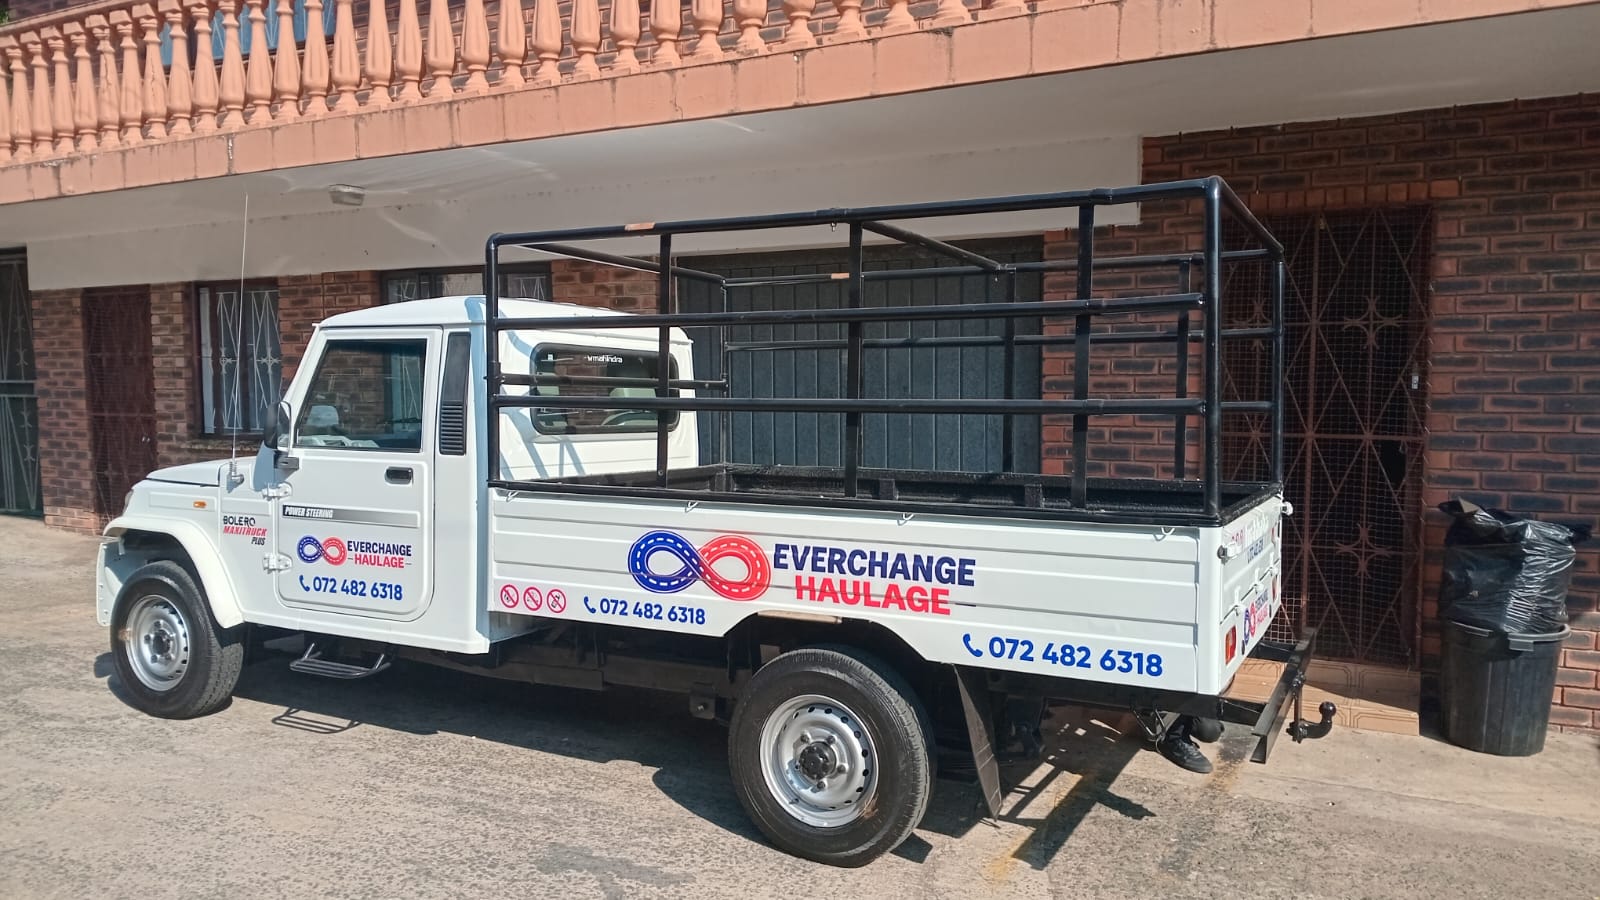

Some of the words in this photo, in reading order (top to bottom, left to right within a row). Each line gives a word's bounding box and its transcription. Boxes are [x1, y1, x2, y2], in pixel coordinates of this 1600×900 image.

[223, 515, 256, 527] BOLERO
[284, 506, 305, 517] POWER
[306, 508, 334, 519] STEERING
[223, 525, 267, 537] MAXITRUCK
[251, 536, 266, 546] PLUS
[347, 540, 412, 557] EVERCHANGE
[354, 553, 405, 569] HAULAGE
[773, 543, 976, 587] EVERCHANGE
[313, 576, 337, 594] 072
[341, 579, 367, 597] 482
[370, 582, 403, 601] 6318
[795, 575, 951, 615] HAULAGE
[600, 598, 628, 616] 072
[632, 601, 663, 620] 482
[667, 605, 706, 625] 6318
[988, 636, 1034, 662] 072
[1042, 643, 1091, 669] 482
[1100, 649, 1163, 677] 6318
